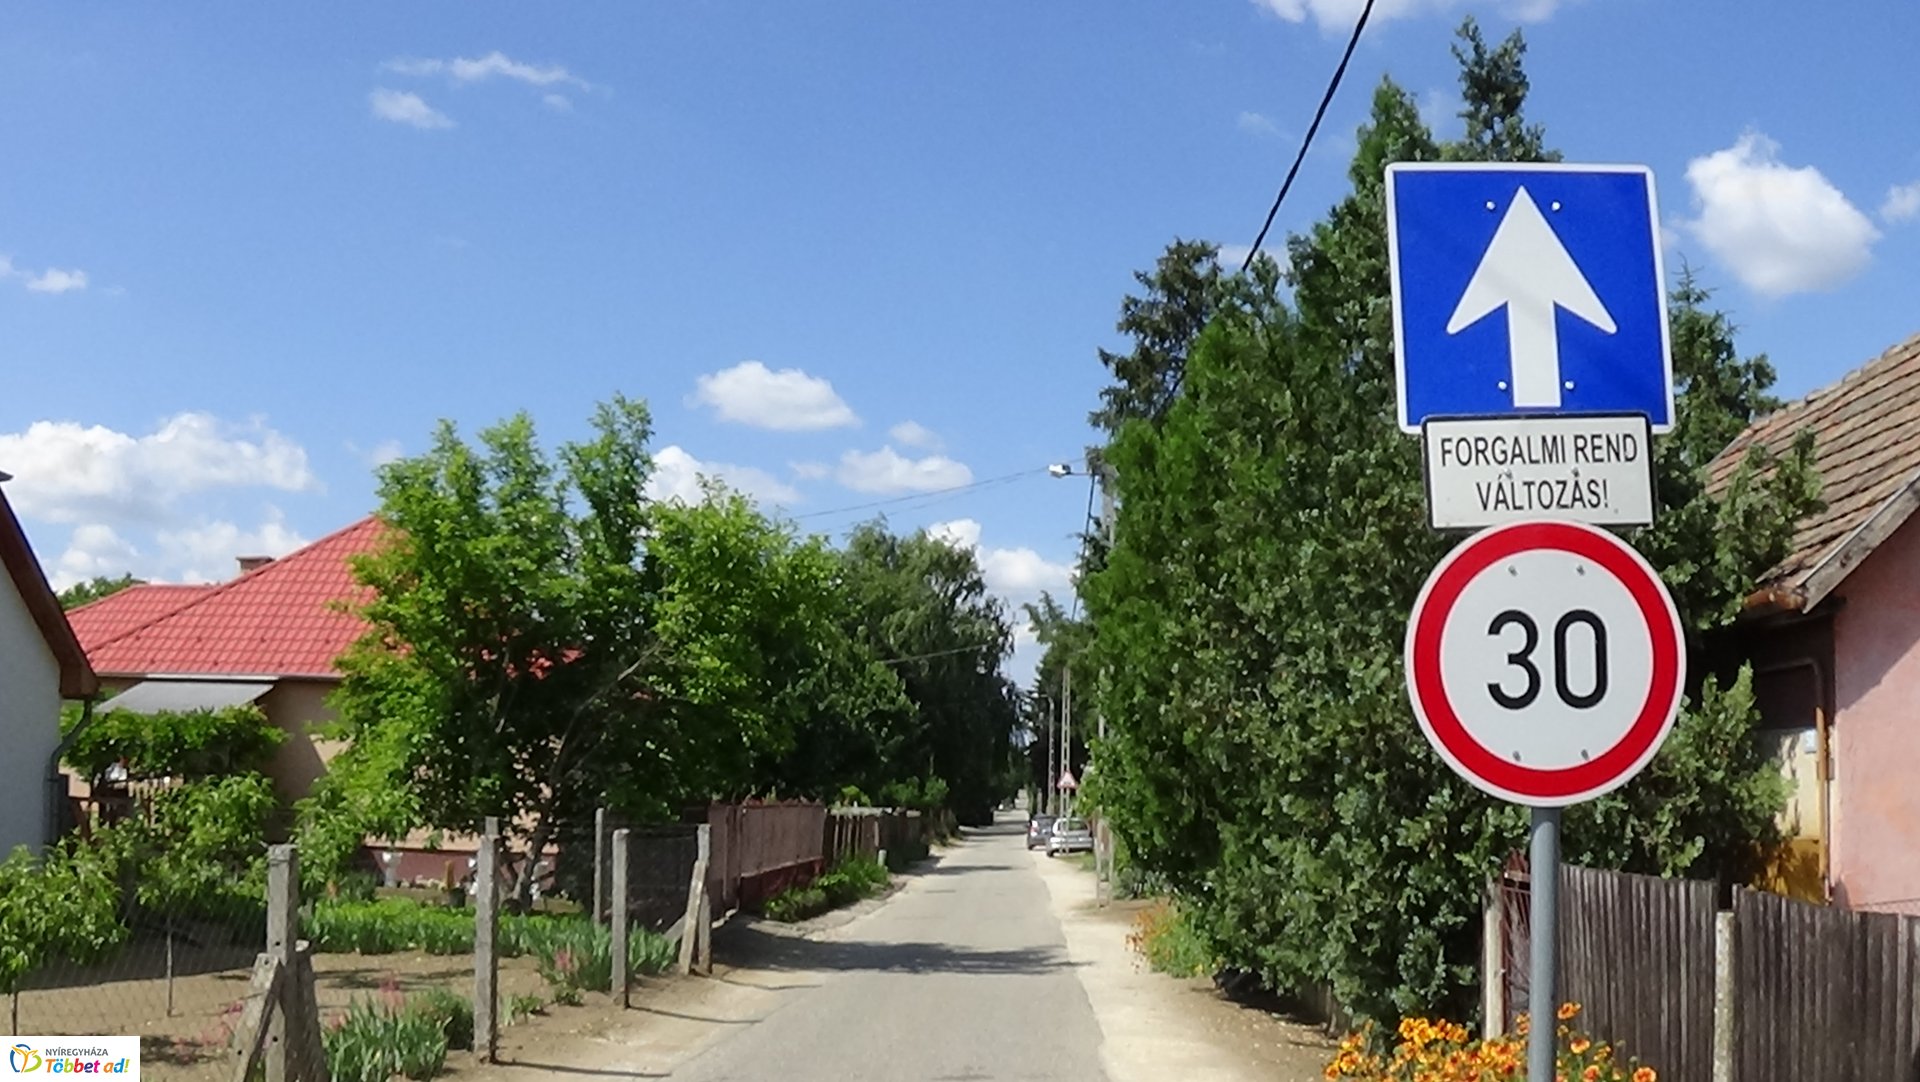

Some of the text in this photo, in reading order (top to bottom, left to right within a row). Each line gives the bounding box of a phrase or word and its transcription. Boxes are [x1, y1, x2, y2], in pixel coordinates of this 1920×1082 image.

[1441, 433, 1638, 467] FORGALMI REND
[1476, 472, 1609, 511] VÁLTOZÁS!
[1487, 609, 1608, 710] 30
